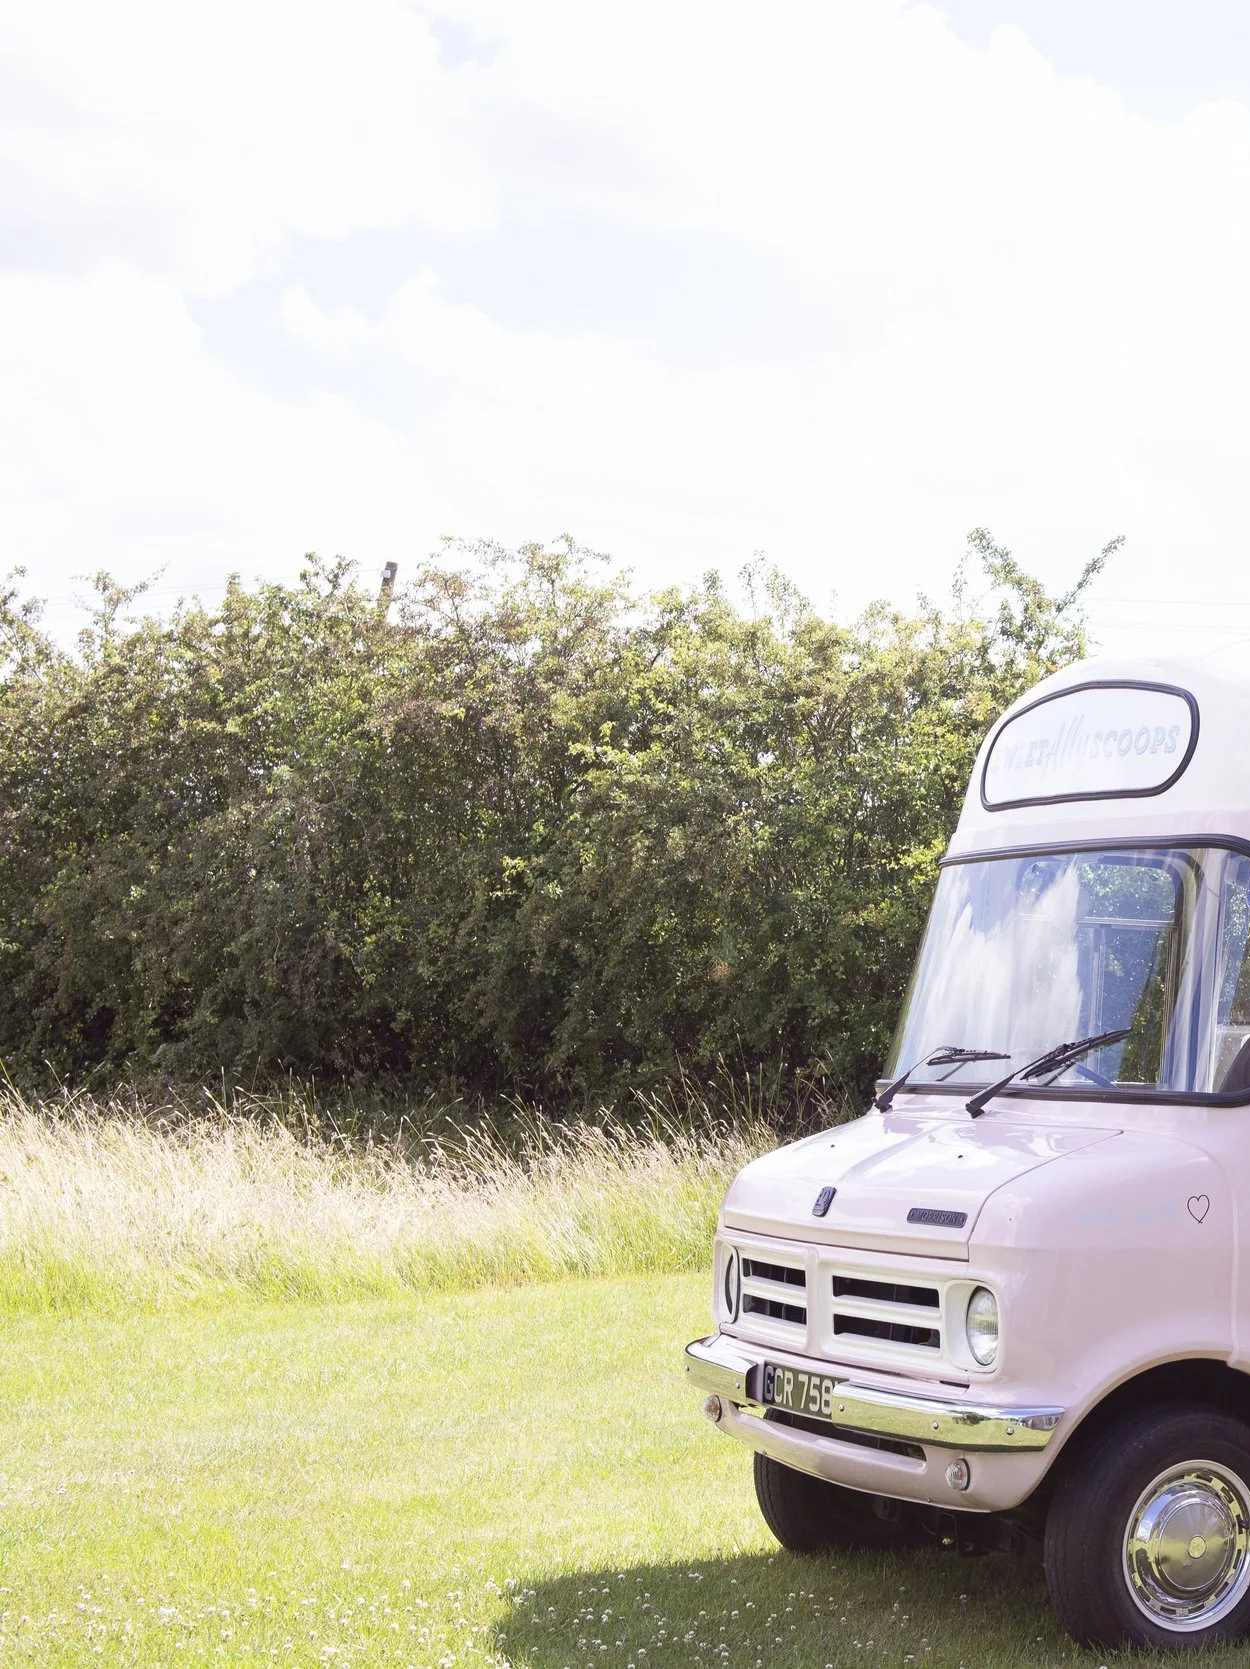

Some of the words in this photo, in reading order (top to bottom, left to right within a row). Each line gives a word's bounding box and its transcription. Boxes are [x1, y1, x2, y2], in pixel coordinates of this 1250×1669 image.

[1089, 724, 1181, 760] SCOOPS
[916, 1210, 958, 1225] MORRISON
[764, 1365, 794, 1407] GCR
[798, 1373, 841, 1415] 758
